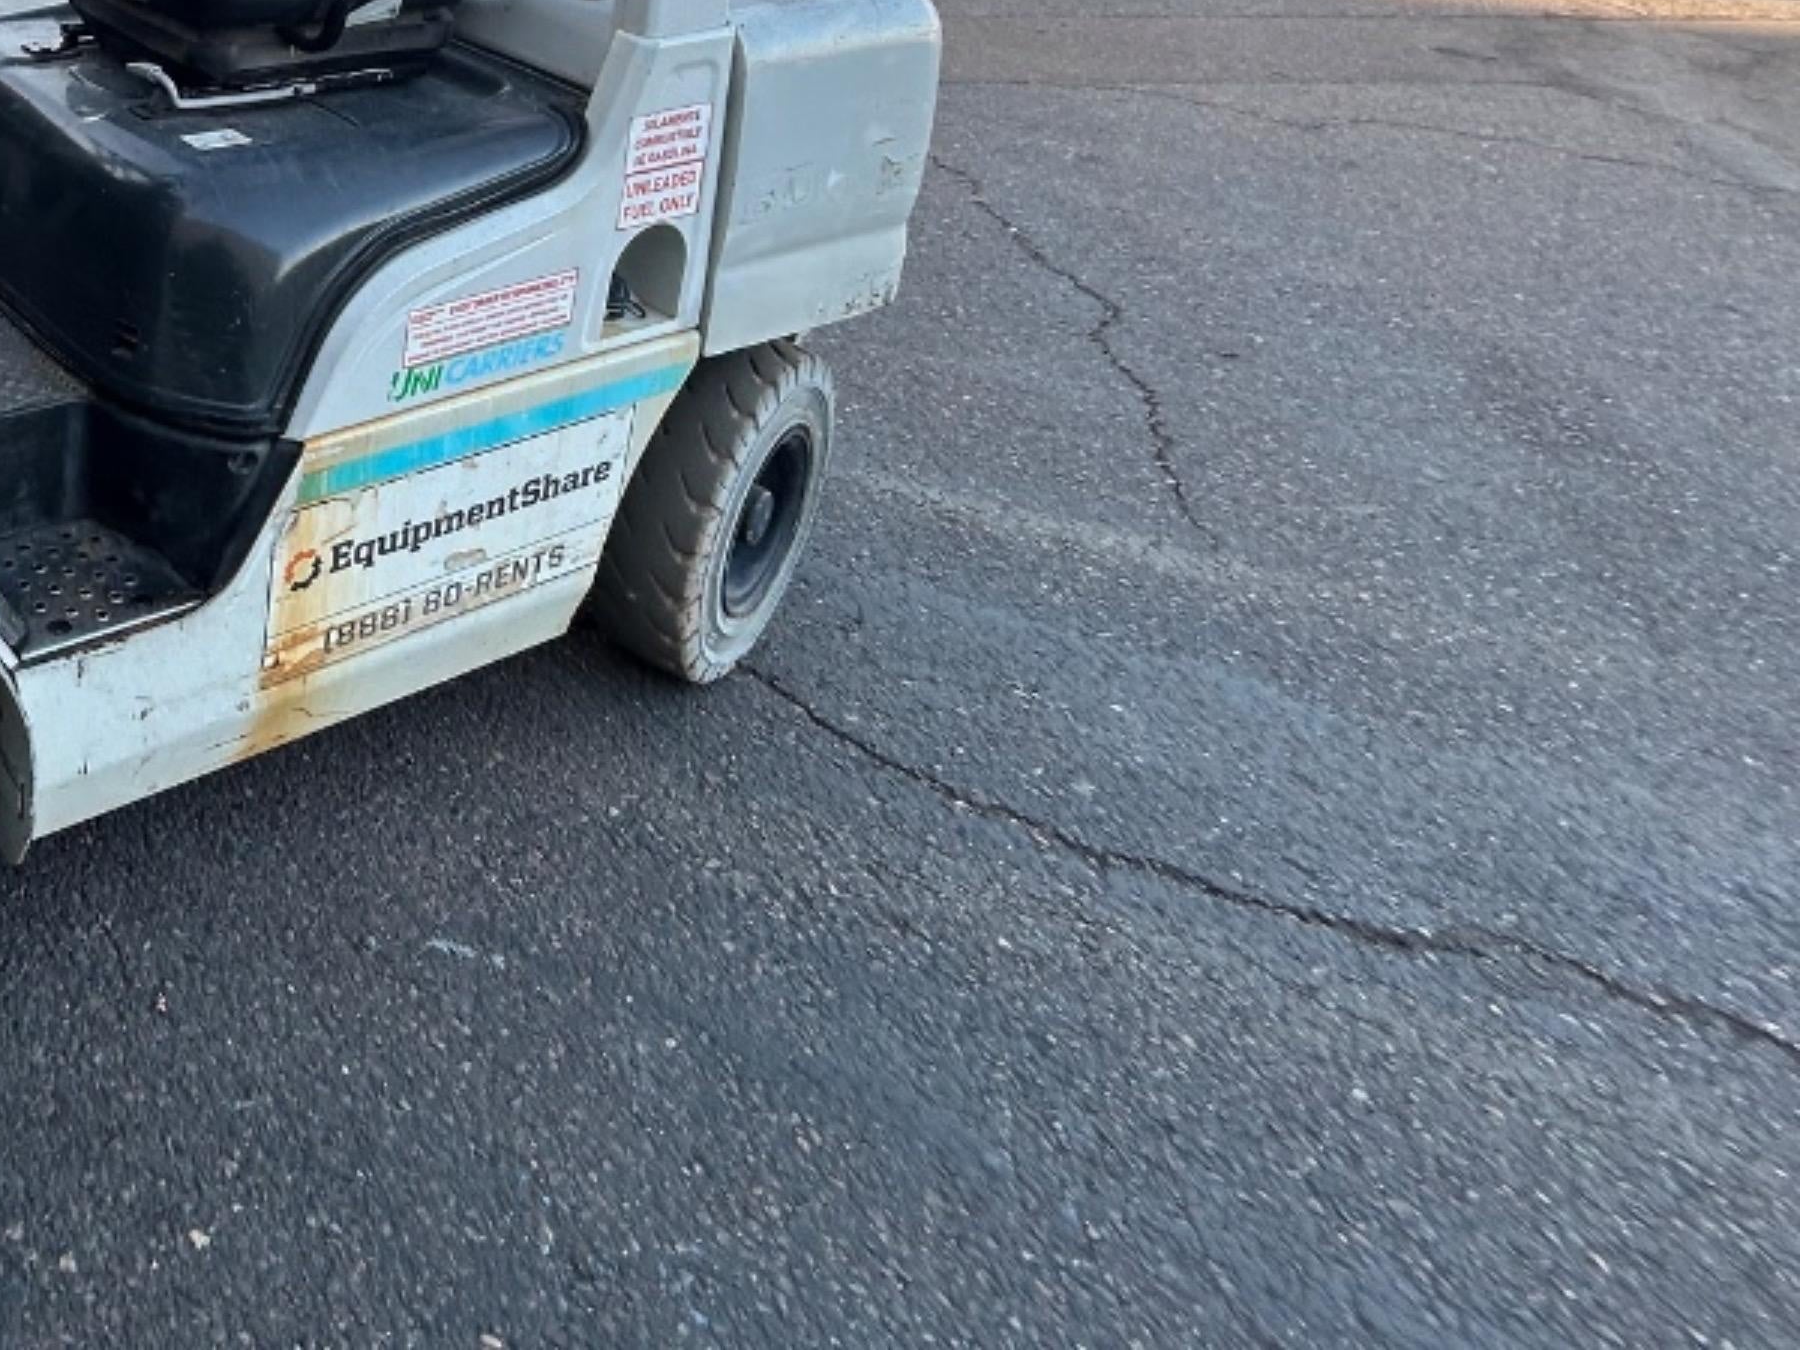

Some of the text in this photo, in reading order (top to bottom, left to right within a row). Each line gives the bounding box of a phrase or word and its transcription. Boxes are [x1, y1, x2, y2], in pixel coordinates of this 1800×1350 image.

[626, 170, 697, 198] UNLEADED
[660, 192, 696, 213] ONLY
[329, 460, 612, 574] EquipmentShare
[323, 598, 413, 651] (888)
